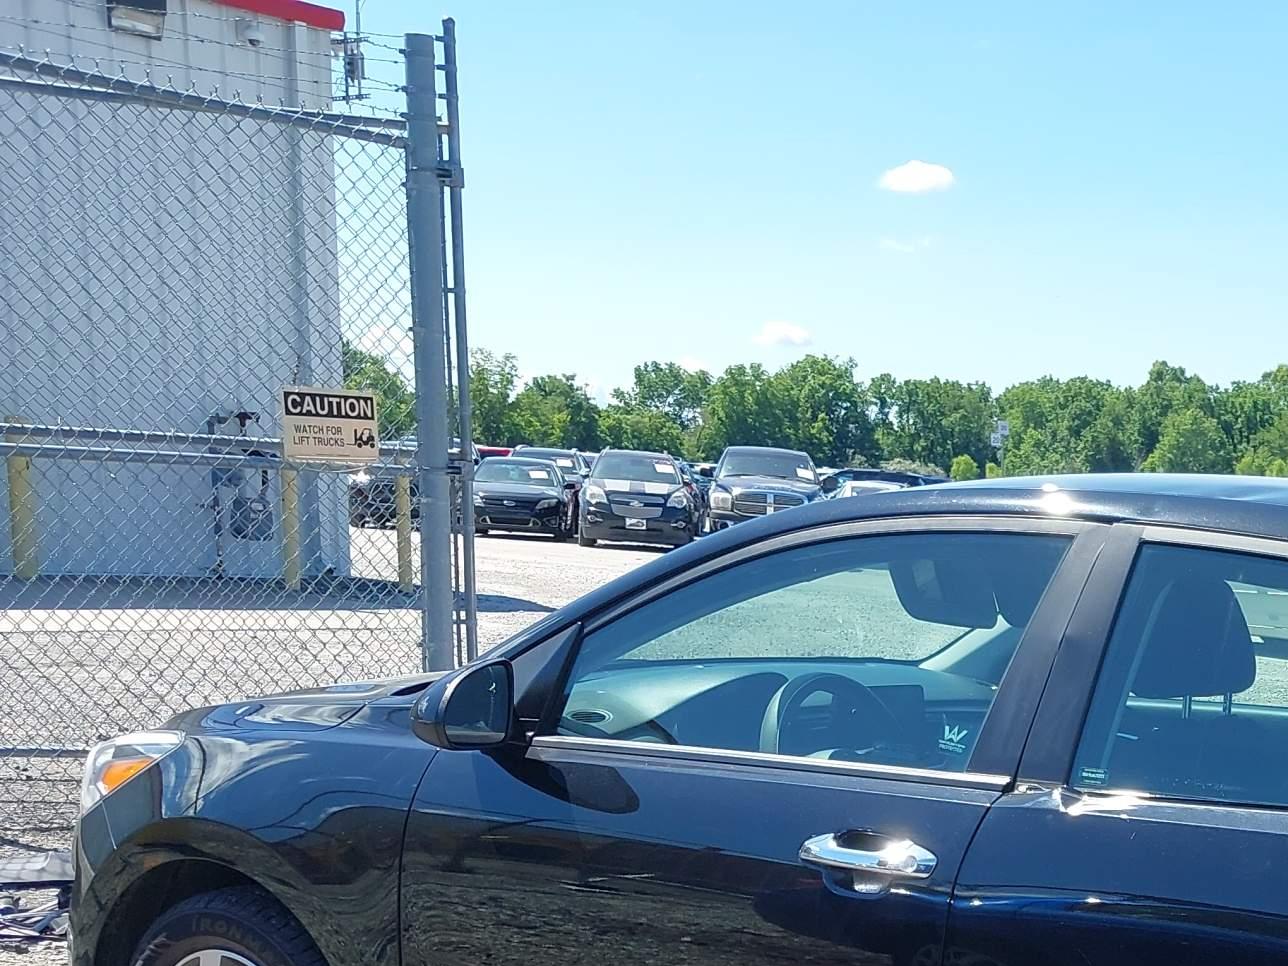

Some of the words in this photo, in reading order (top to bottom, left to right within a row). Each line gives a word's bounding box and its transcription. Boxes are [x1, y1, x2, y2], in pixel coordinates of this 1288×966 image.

[287, 394, 373, 418] CAUTION
[294, 424, 324, 435] WATCH
[326, 426, 343, 436] FOR
[293, 436, 310, 446] LIFT
[312, 437, 345, 447] TRUCKS
